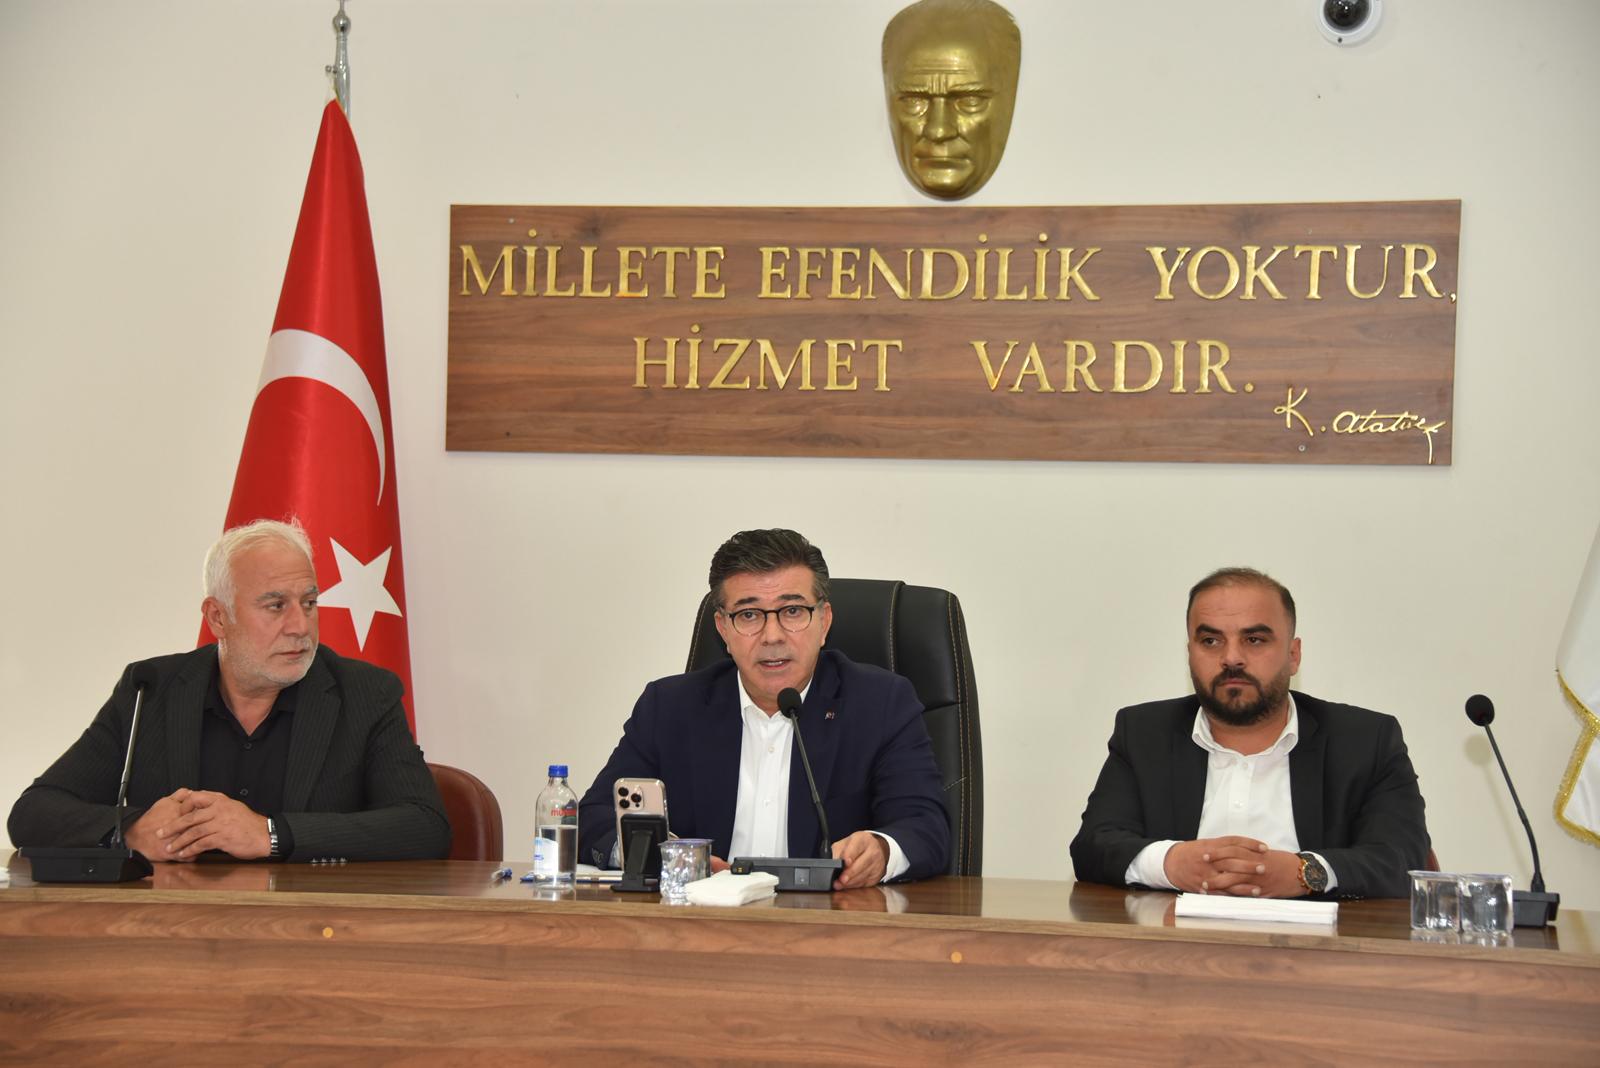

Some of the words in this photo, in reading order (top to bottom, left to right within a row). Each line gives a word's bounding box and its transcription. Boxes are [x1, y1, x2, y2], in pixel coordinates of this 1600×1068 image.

[459, 228, 726, 299] MİLLETE
[757, 232, 1102, 301] EFENDİLİK
[1145, 243, 1457, 302] YOKTUR,
[632, 324, 903, 392] HİZMET
[970, 340, 1255, 394] VARDIR.
[1273, 387, 1327, 437] K.
